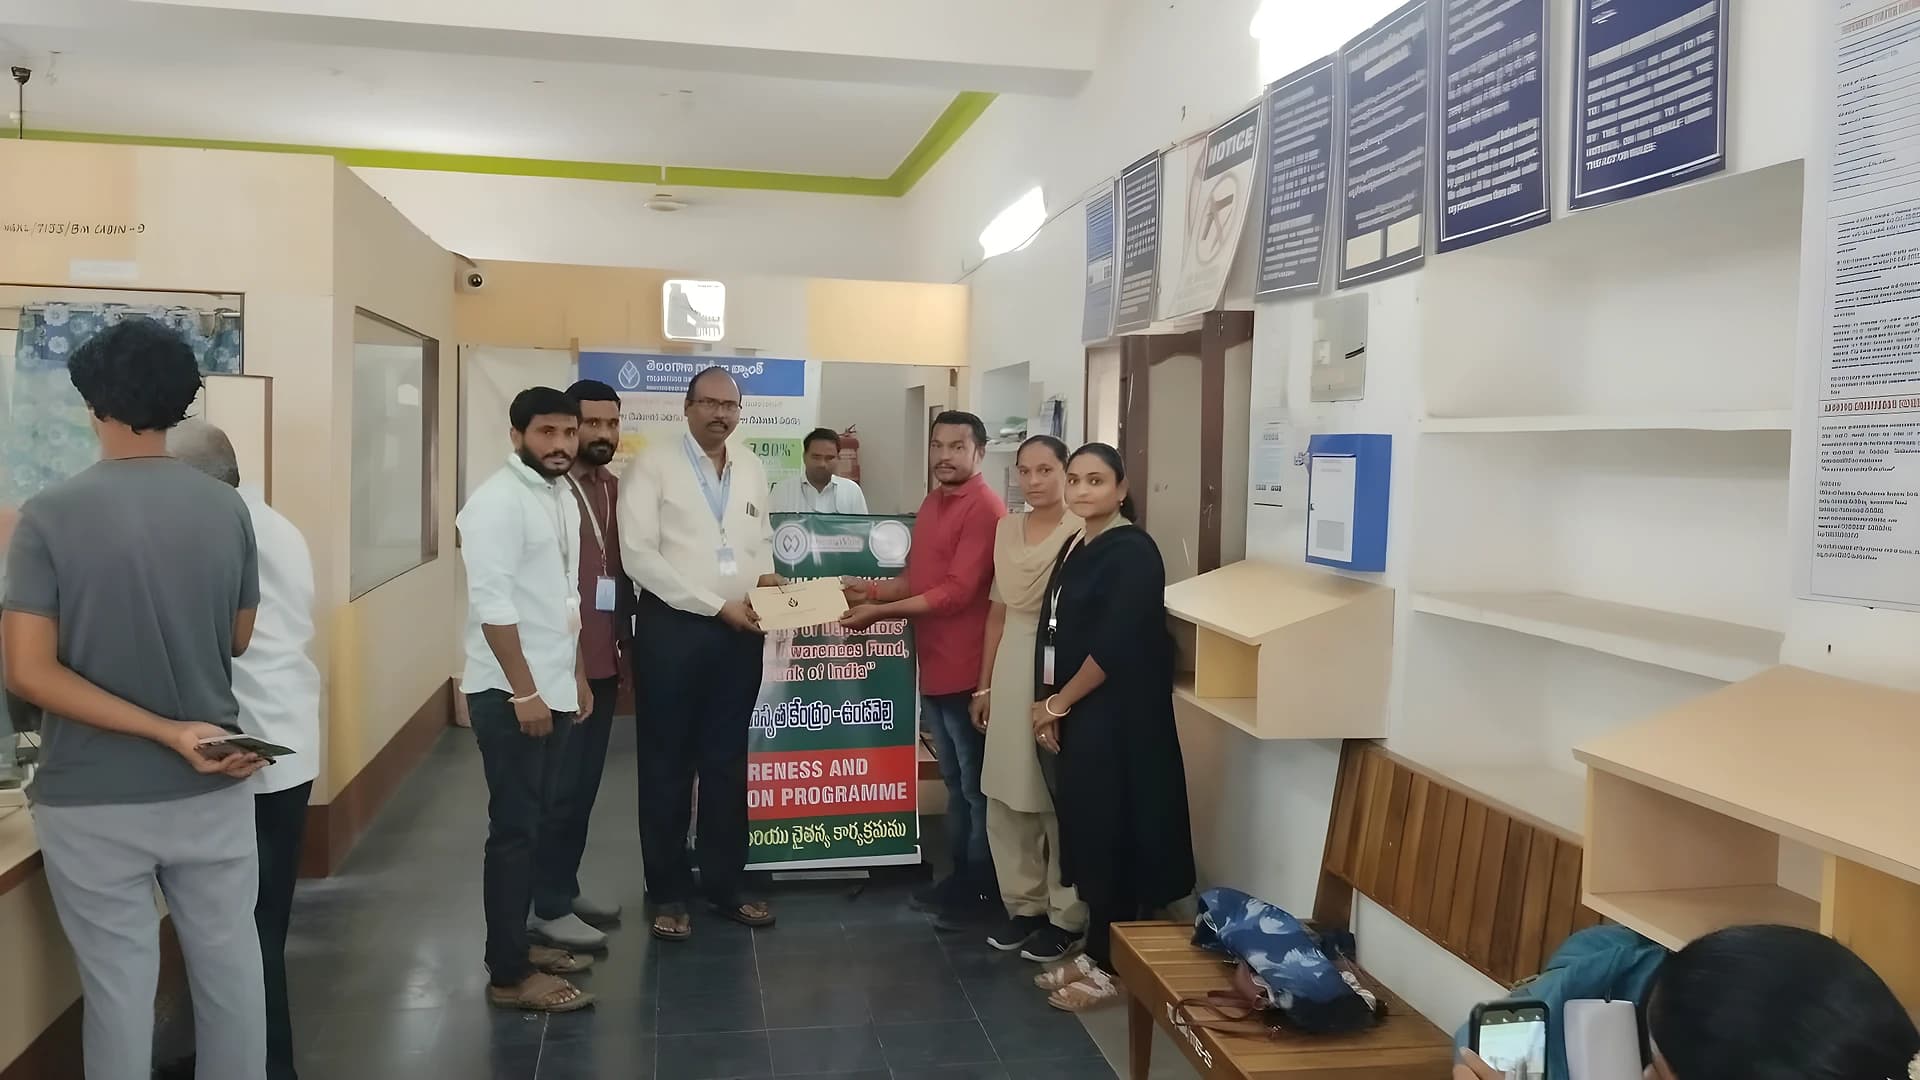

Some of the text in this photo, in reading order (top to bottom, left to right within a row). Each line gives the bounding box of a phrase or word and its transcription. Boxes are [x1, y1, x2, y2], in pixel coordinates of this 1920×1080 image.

[1208, 124, 1256, 167] NOTICE
[807, 662, 824, 681] of
[829, 757, 868, 777] AND
[781, 781, 907, 807] PROGRAMME
